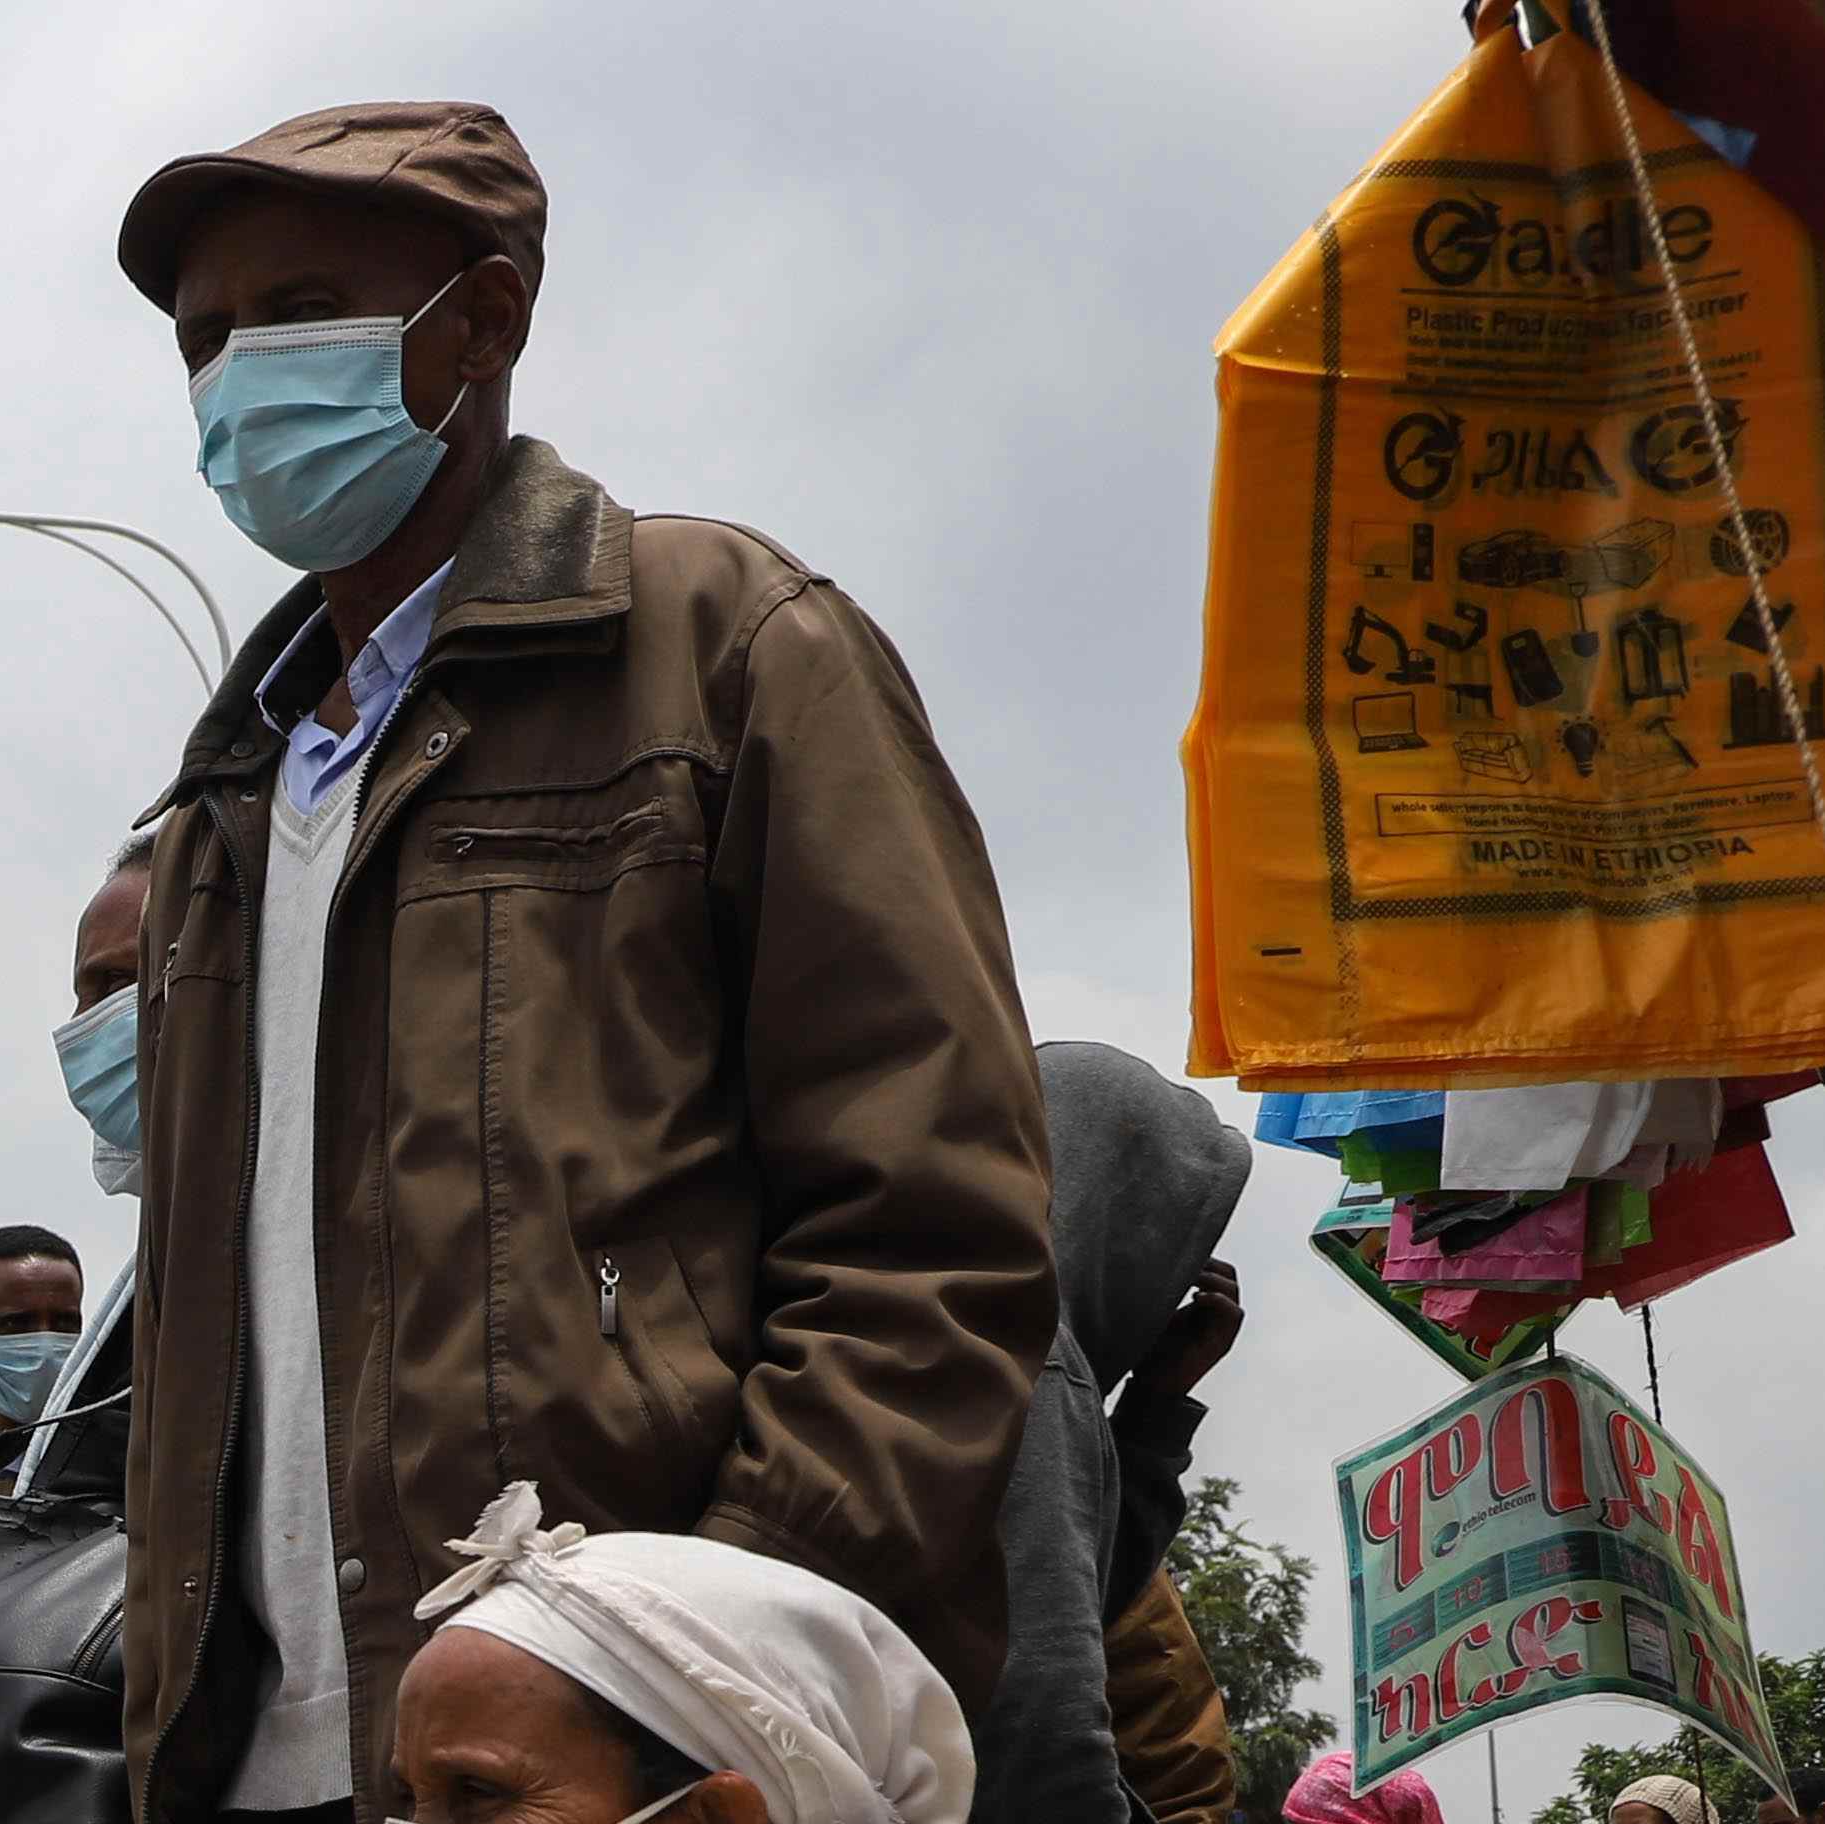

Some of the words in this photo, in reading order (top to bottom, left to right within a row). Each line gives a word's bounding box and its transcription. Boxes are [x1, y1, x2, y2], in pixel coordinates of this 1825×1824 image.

[1407, 306, 1483, 336] Plastic
[1472, 839, 1557, 863] MADE
[1562, 843, 1585, 866] IN
[1593, 836, 1755, 870] ETHIOPIA
[1462, 1510, 1487, 1533] ethio
[1487, 1492, 1536, 1516] telecom
[1371, 1596, 1605, 1743] ካርድ
